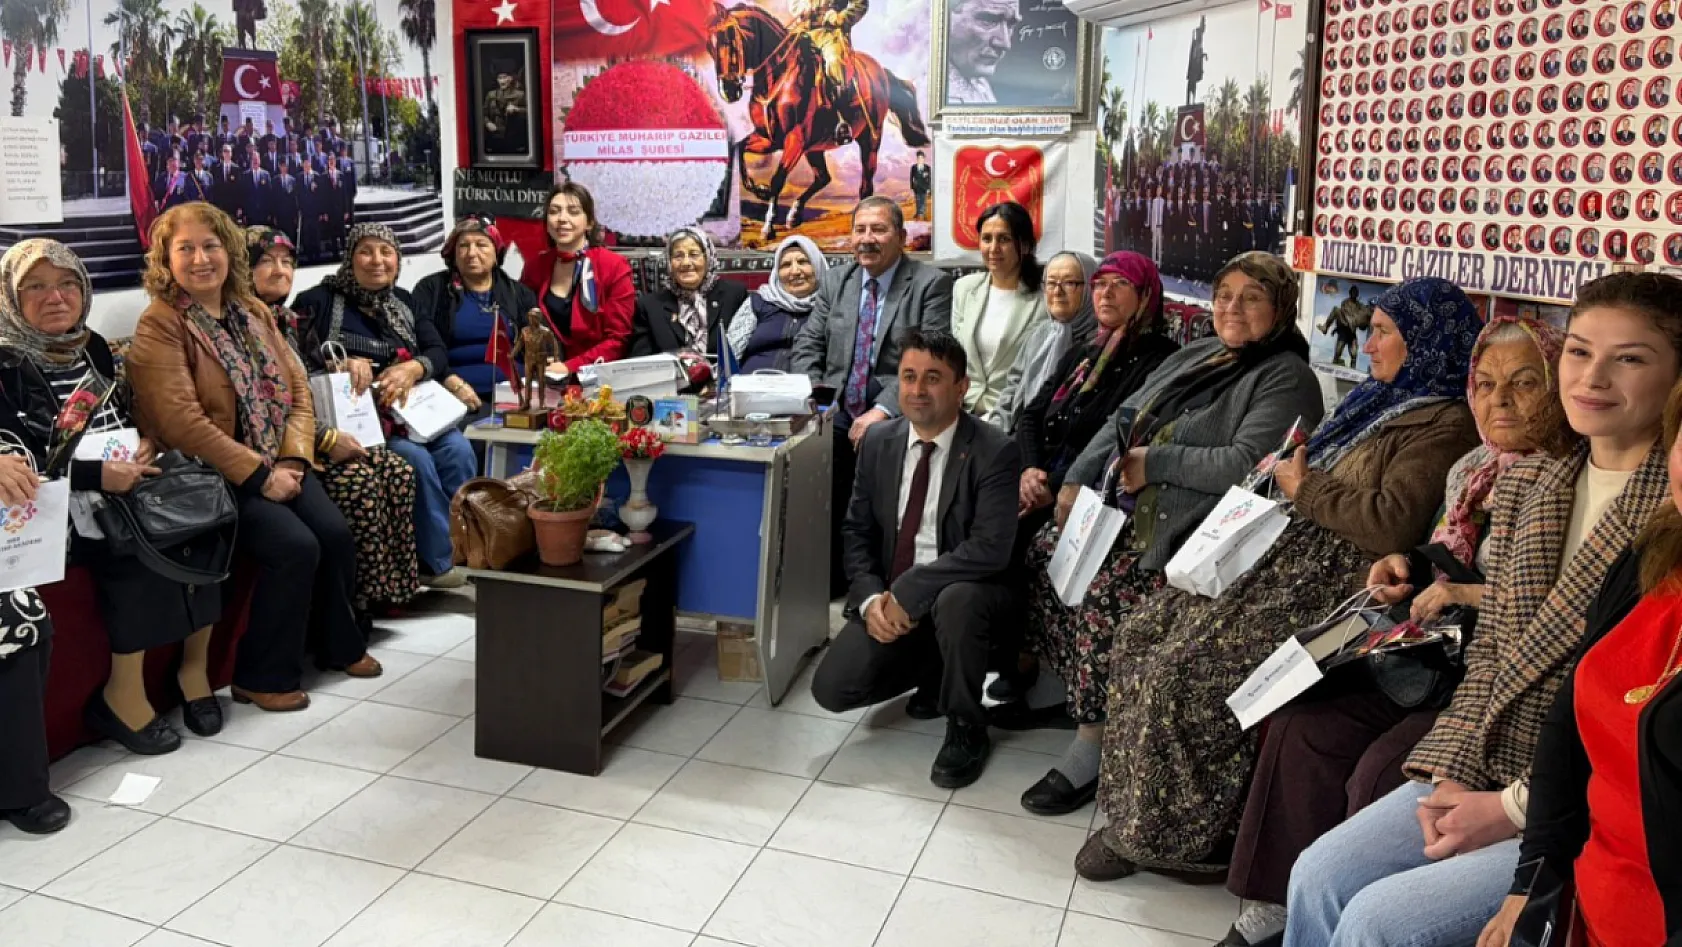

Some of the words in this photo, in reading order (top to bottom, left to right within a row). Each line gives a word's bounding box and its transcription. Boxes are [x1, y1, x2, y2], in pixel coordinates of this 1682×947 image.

[565, 131, 616, 143] TÜRKİYE
[618, 130, 675, 141] MUHARİP
[597, 143, 633, 156] MİLAS
[641, 143, 684, 156] ŞUBESİ
[455, 169, 474, 181] NE
[478, 169, 522, 183] MUTLU
[517, 187, 549, 204] DİYE
[1320, 240, 1397, 278] MUHARIP
[1401, 246, 1486, 290] GAZILER
